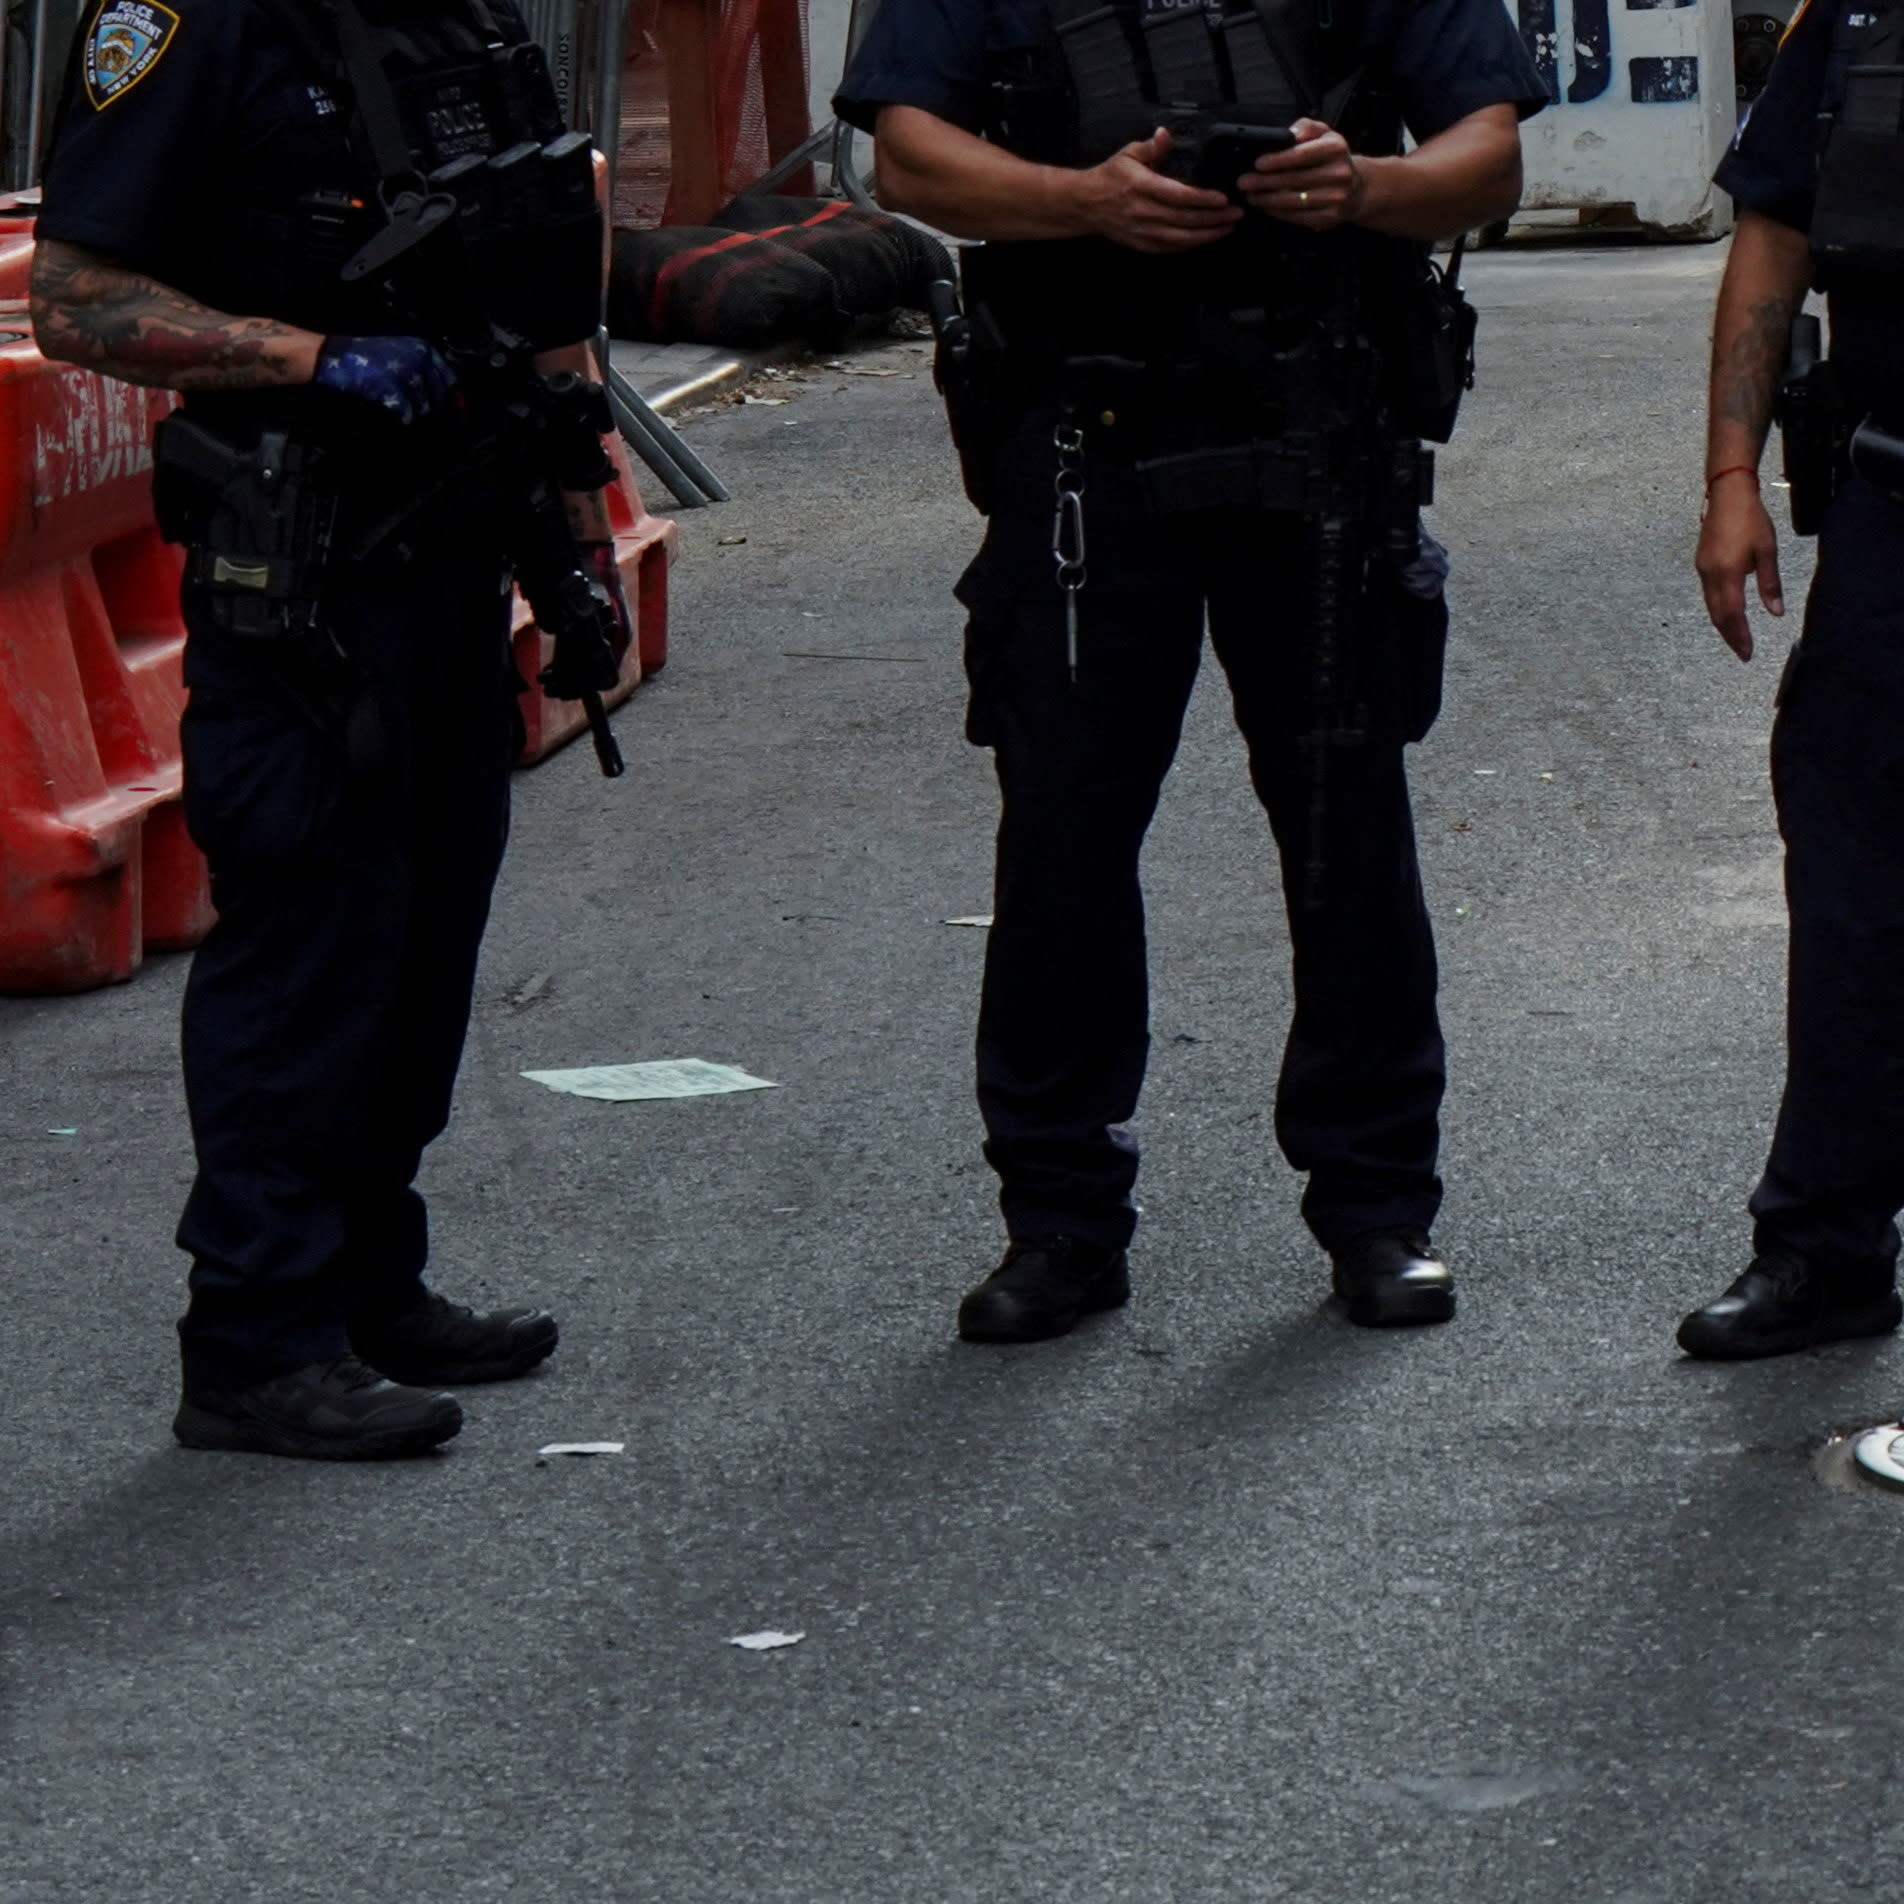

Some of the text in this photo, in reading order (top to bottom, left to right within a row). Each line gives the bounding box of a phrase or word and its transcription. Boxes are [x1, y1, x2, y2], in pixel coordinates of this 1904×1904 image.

[99, 11, 165, 41] DEPARTMENT
[116, 0, 155, 22] POLICE
[106, 46, 159, 96] NEW YORK
[427, 101, 487, 135] POLICE
